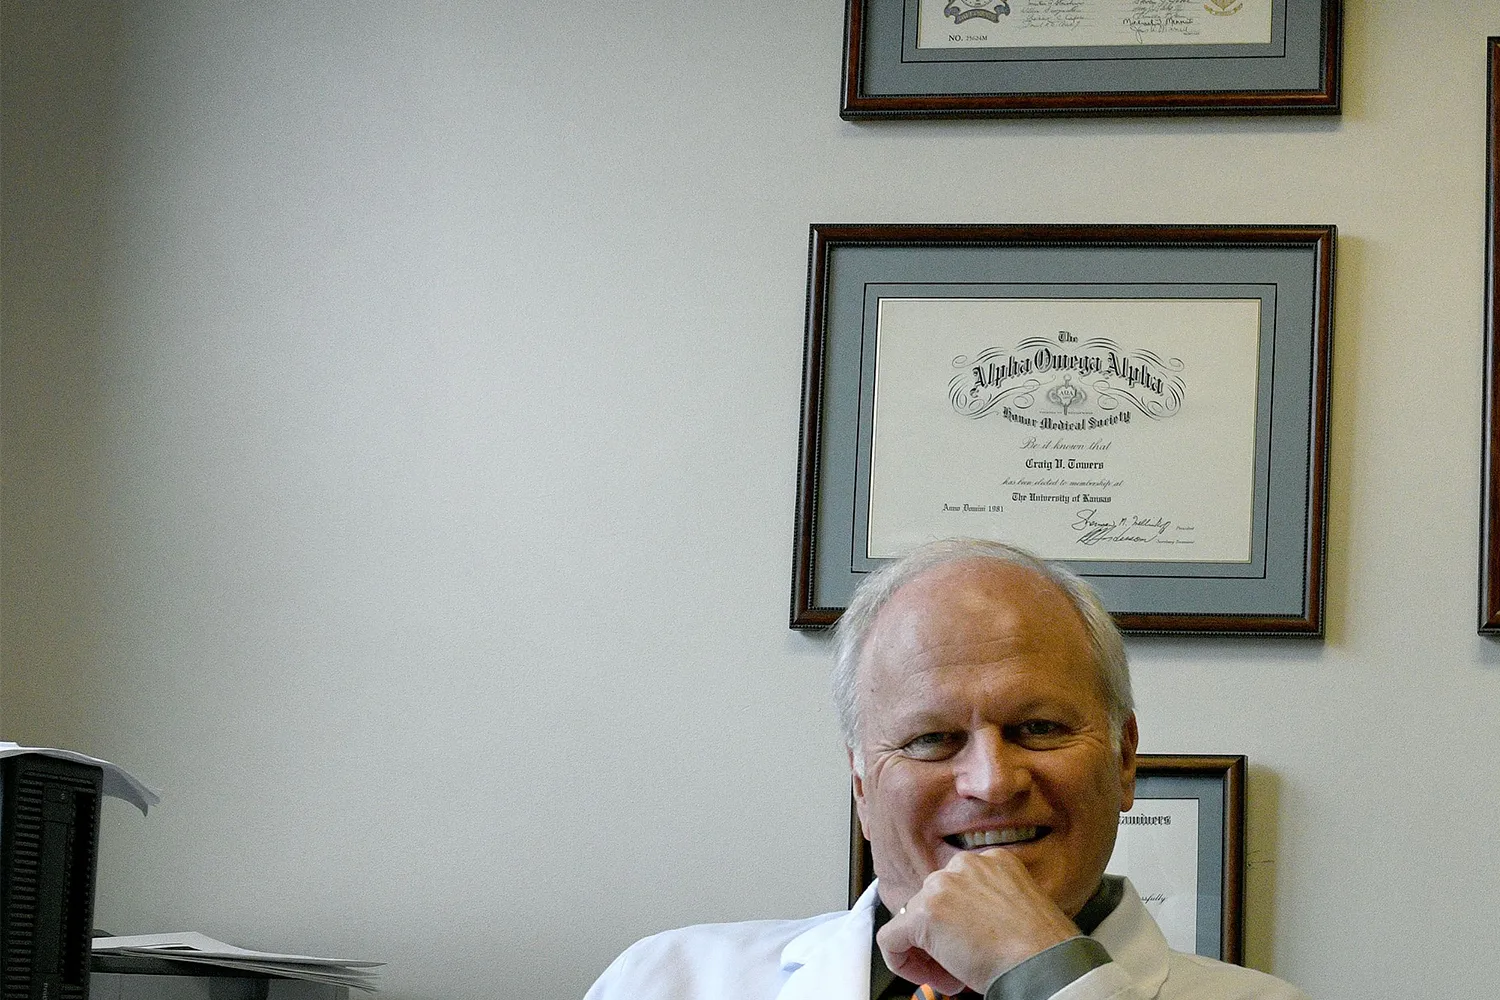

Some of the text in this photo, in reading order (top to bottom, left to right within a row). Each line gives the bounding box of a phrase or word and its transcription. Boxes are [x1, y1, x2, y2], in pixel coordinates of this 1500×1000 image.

[948, 34, 963, 42] NO.
[1058, 330, 1079, 343] The
[970, 348, 1164, 398] Alpha Omega Alpha
[1002, 407, 1131, 431] Honor Medical Society
[1020, 437, 1112, 450] Be it known that
[1025, 459, 1104, 471] Craig V. Towers
[1011, 492, 1112, 504] The University of Kansas
[942, 503, 1004, 513] Anno Domini 1981
[1117, 814, 1172, 826] aminers
